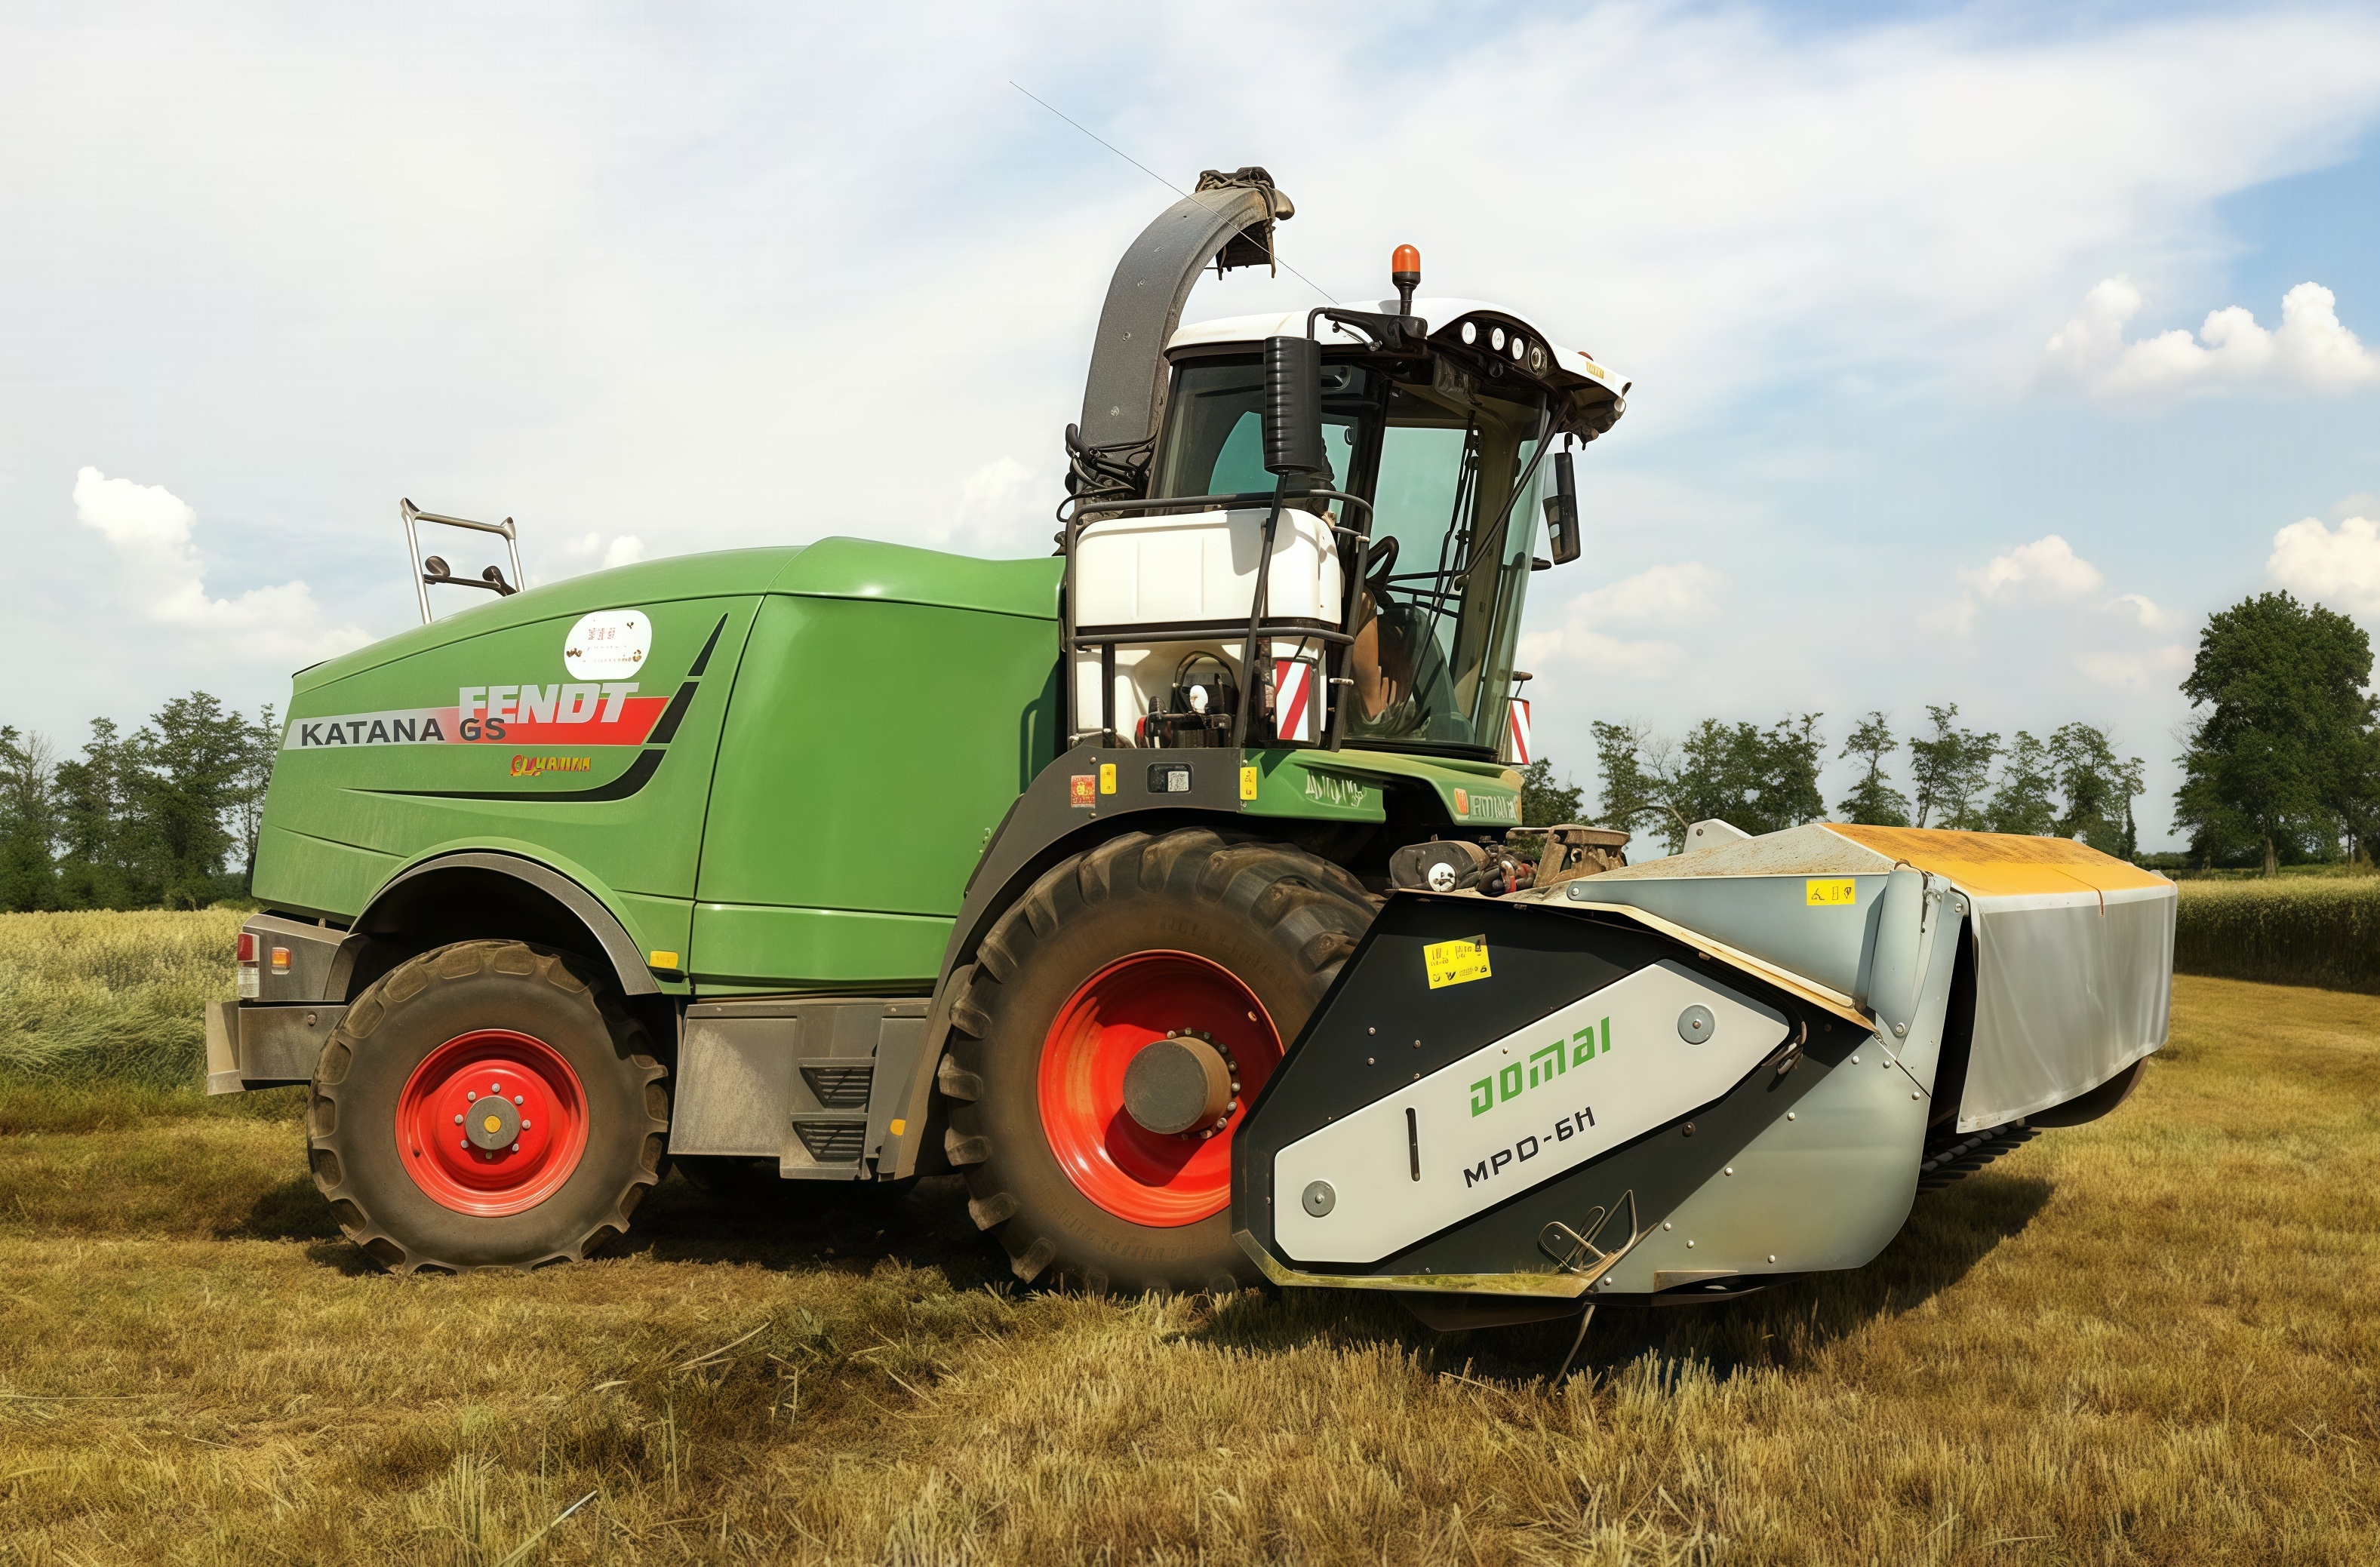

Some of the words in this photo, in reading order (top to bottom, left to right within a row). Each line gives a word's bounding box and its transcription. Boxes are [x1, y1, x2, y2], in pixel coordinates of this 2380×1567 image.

[459, 682, 640, 725] FENDT
[301, 717, 445, 747] KATANA
[459, 717, 506, 742] GS
[1463, 1106, 1596, 1188] MPD-6H
